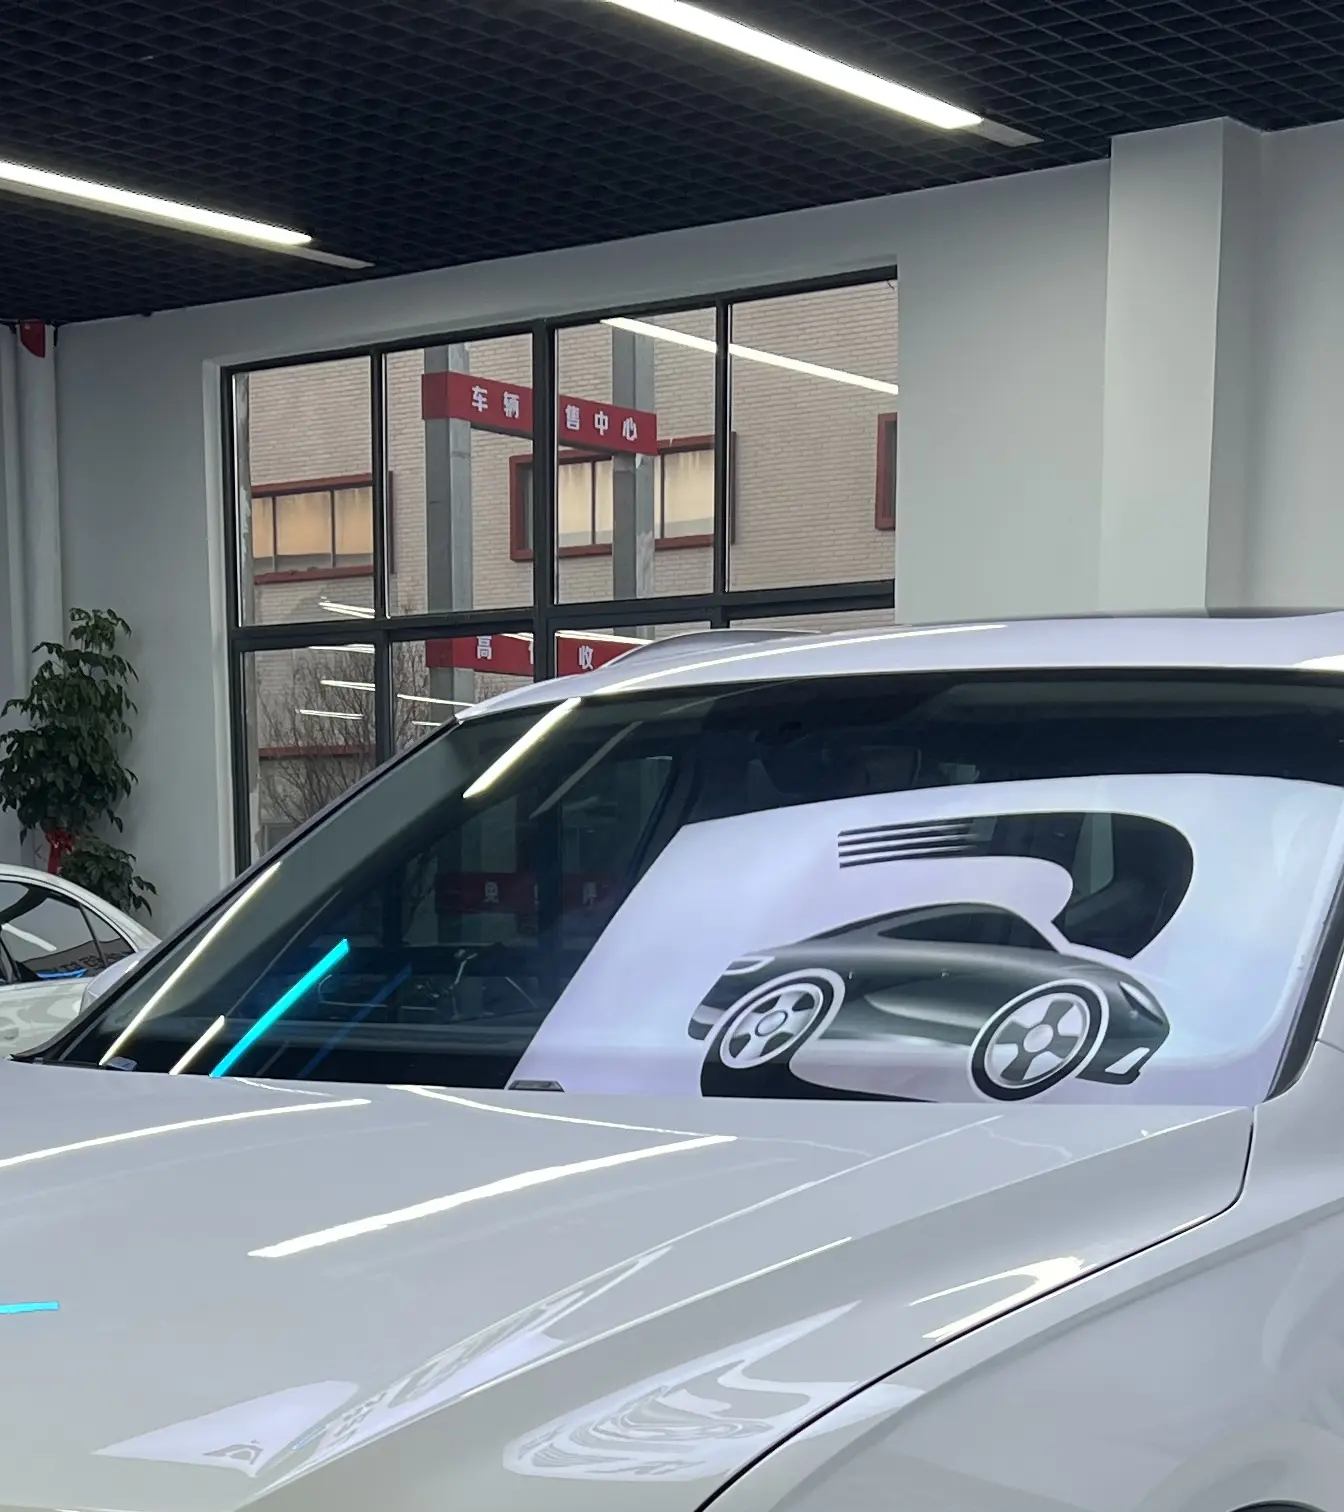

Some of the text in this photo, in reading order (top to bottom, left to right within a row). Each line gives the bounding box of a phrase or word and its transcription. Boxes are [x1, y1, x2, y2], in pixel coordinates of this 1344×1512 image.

[471, 385, 638, 441] 车辆售中心
